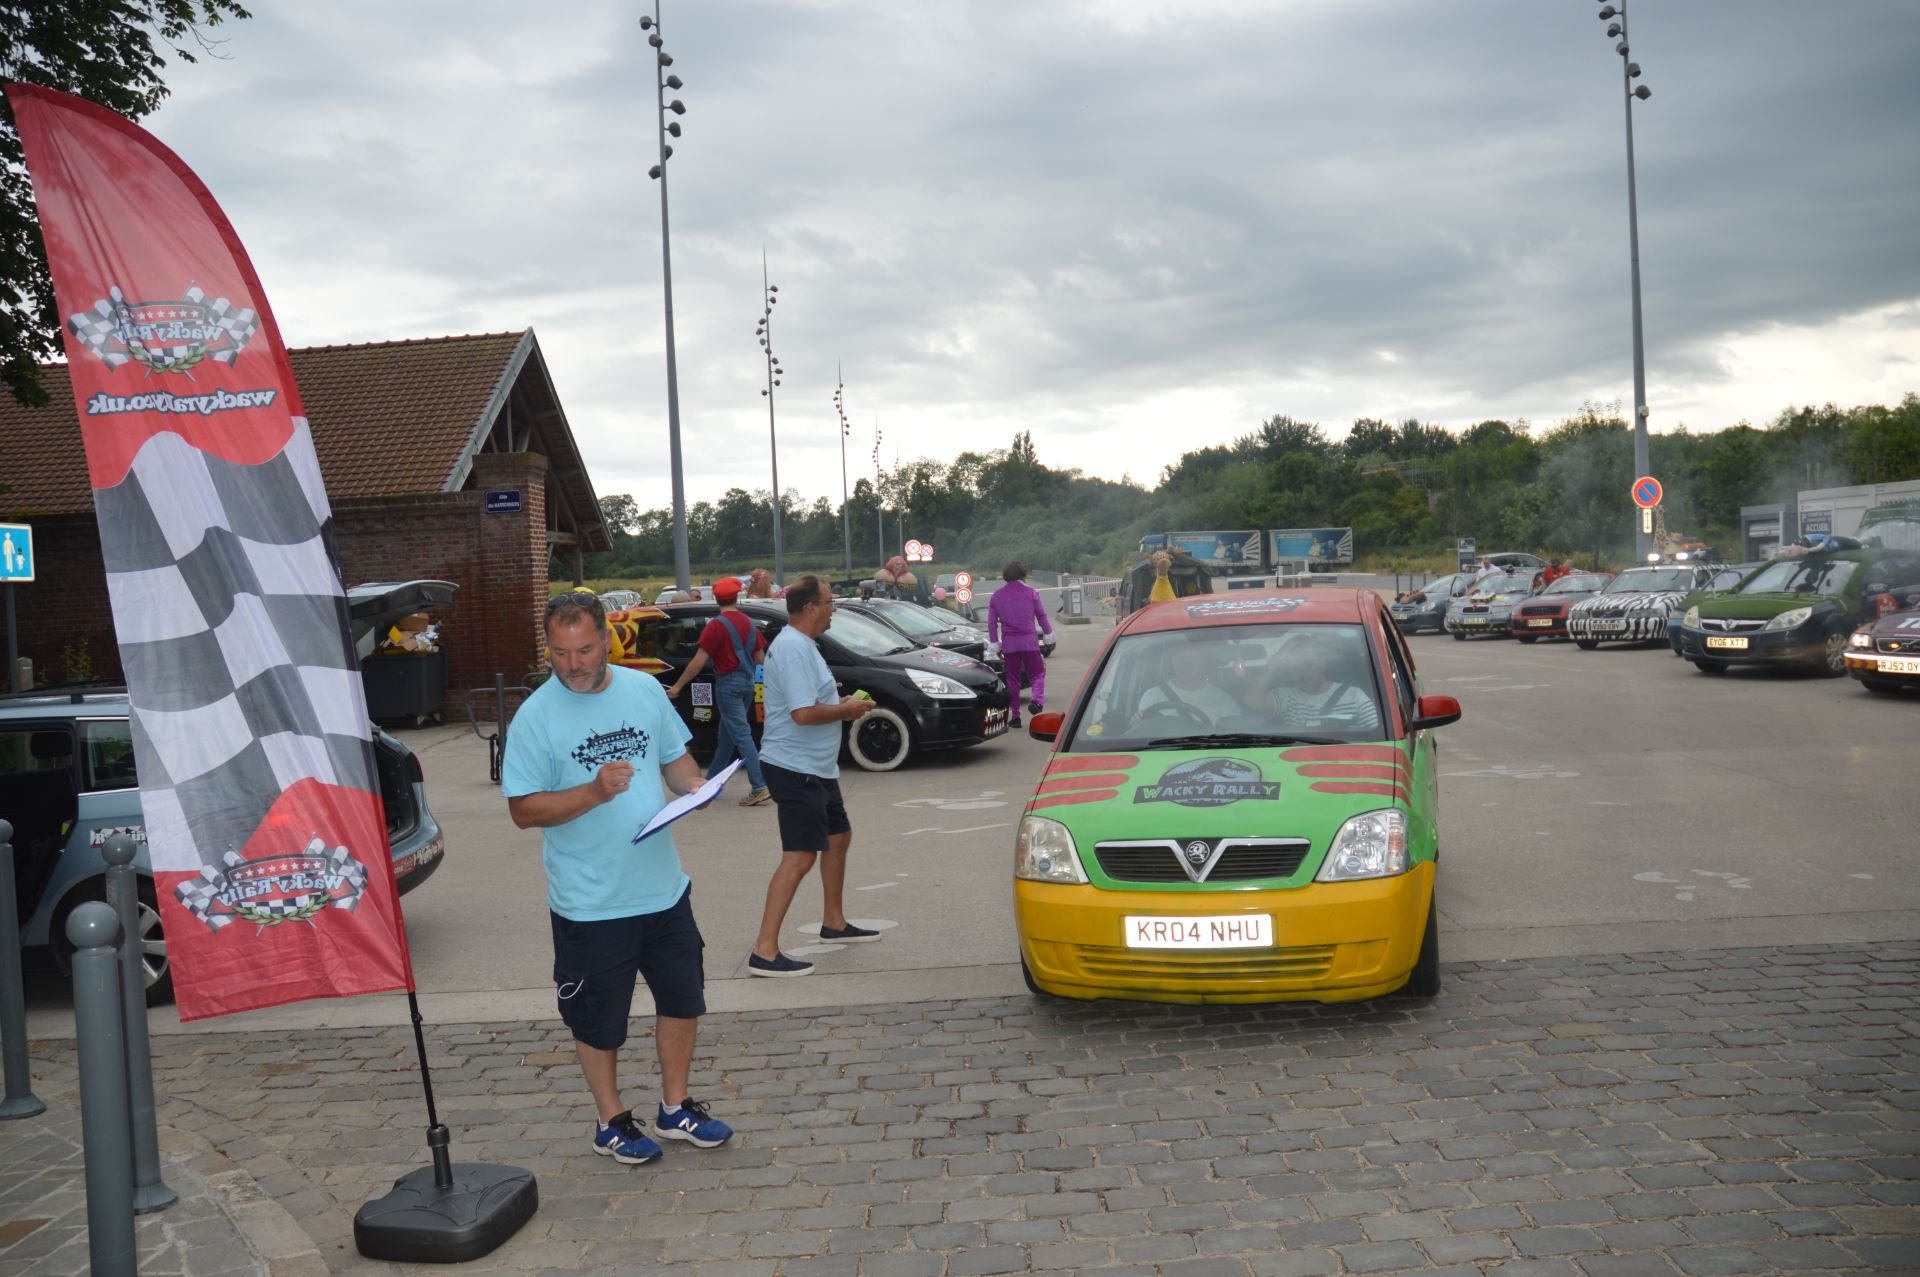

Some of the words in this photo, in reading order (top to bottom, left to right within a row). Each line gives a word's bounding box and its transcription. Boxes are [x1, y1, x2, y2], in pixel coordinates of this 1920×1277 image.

[1730, 638, 1745, 647] XTT
[1881, 661, 1905, 671] RJ52
[1142, 784, 1209, 799] WACKY
[1212, 783, 1277, 796] RALLY
[1137, 921, 1201, 942] KR04
[1210, 920, 1260, 942] NHU
